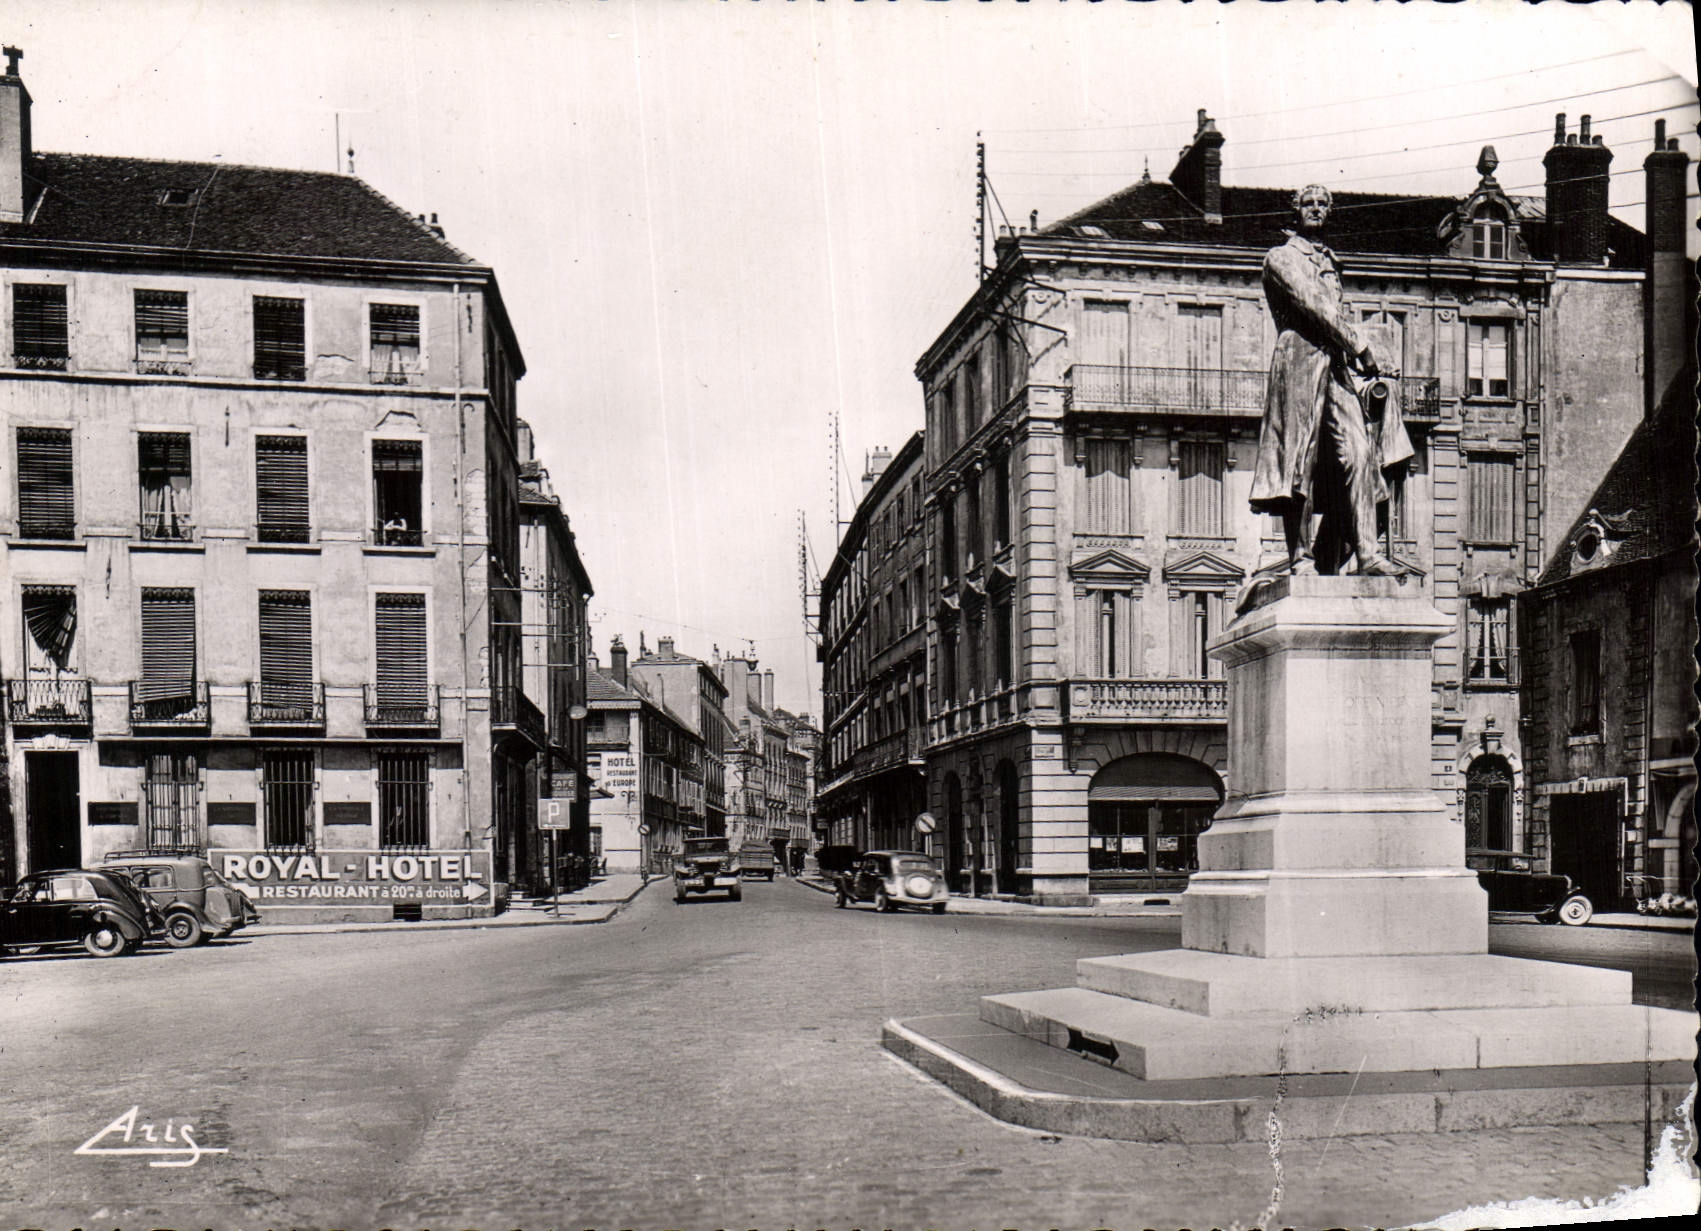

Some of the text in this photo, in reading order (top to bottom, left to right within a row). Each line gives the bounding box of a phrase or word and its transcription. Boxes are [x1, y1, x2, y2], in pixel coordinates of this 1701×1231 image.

[607, 757, 636, 767] HOTEL
[548, 802, 560, 823] P
[222, 855, 340, 880] ROYAL
[367, 855, 483, 880] HOTEL
[262, 885, 379, 898] RESTAURANT
[426, 885, 461, 898] droite
